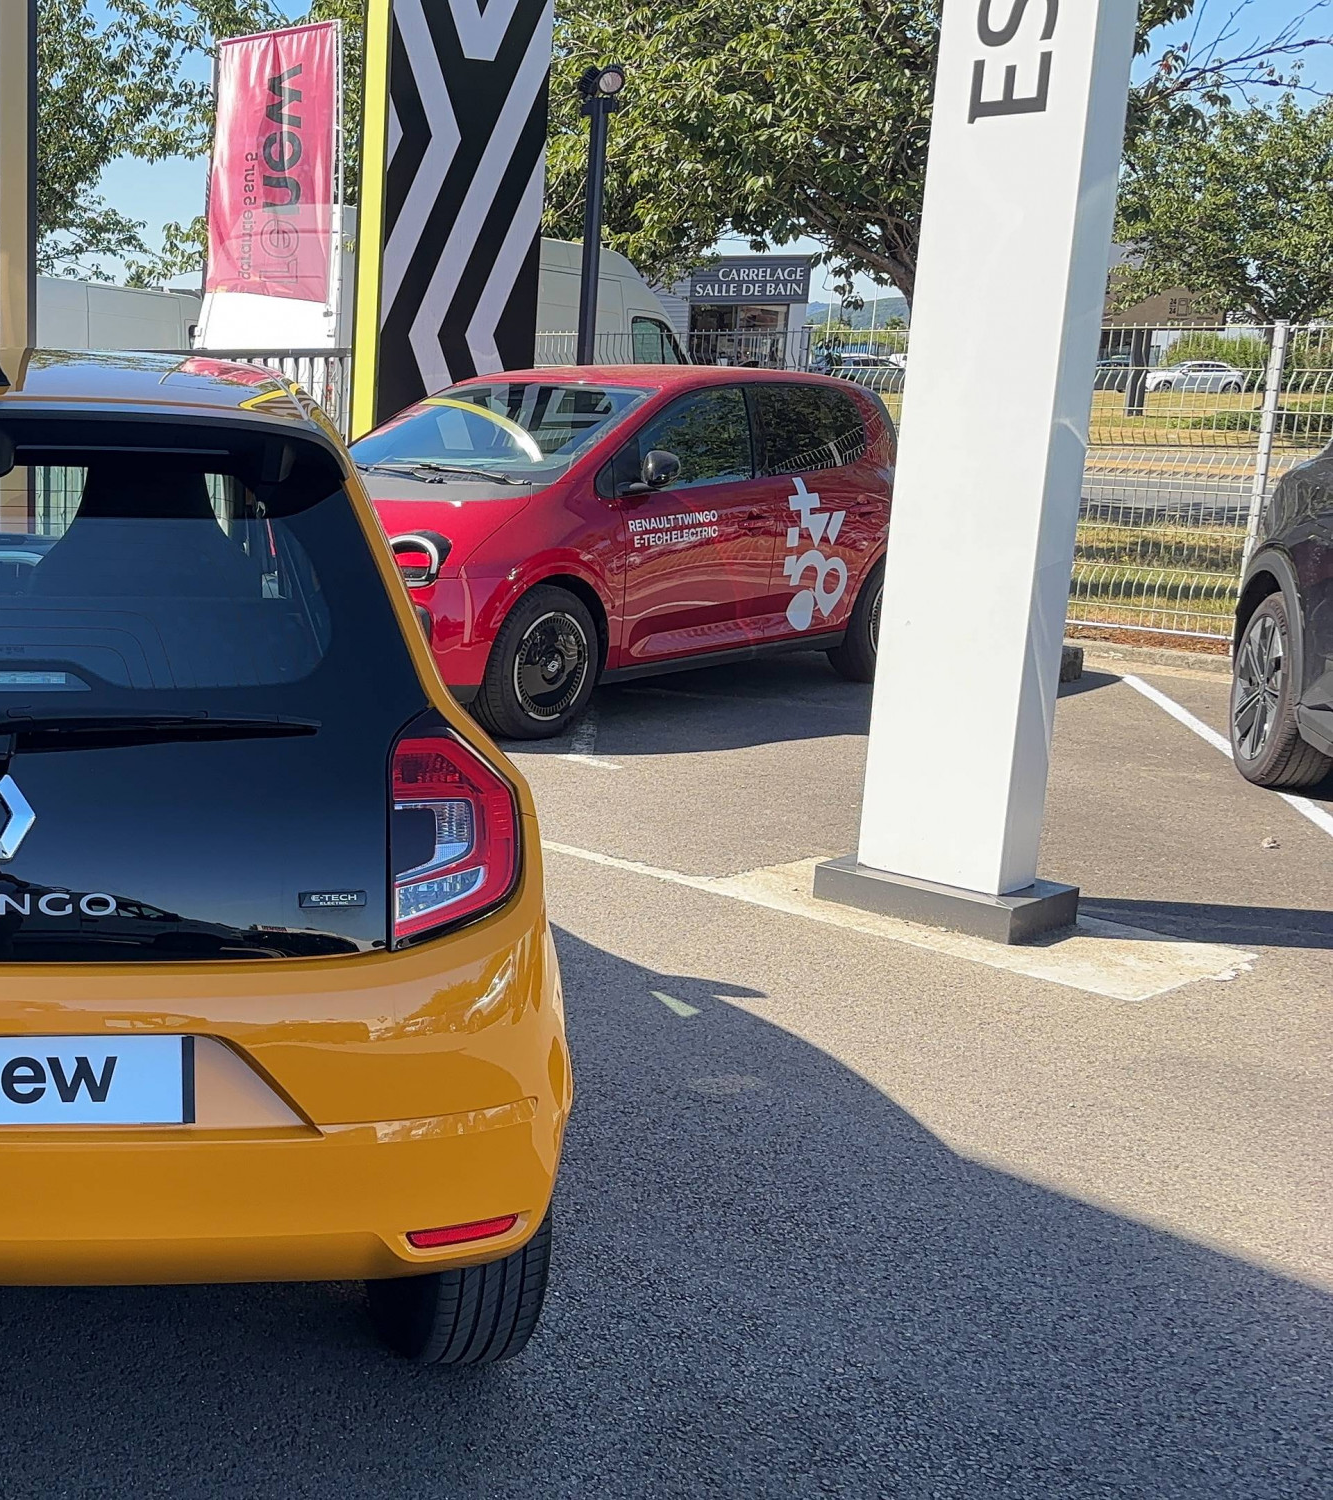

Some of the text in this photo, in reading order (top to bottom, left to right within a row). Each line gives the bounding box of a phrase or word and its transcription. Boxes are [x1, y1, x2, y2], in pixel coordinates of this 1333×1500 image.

[718, 267, 805, 281] CARRELAGE
[695, 282, 804, 296] SALLE DE BAIN
[628, 510, 718, 533] RENAULT TWINGO
[634, 525, 719, 548] E-TECH ELECTRIC
[310, 894, 357, 902] E-TECH
